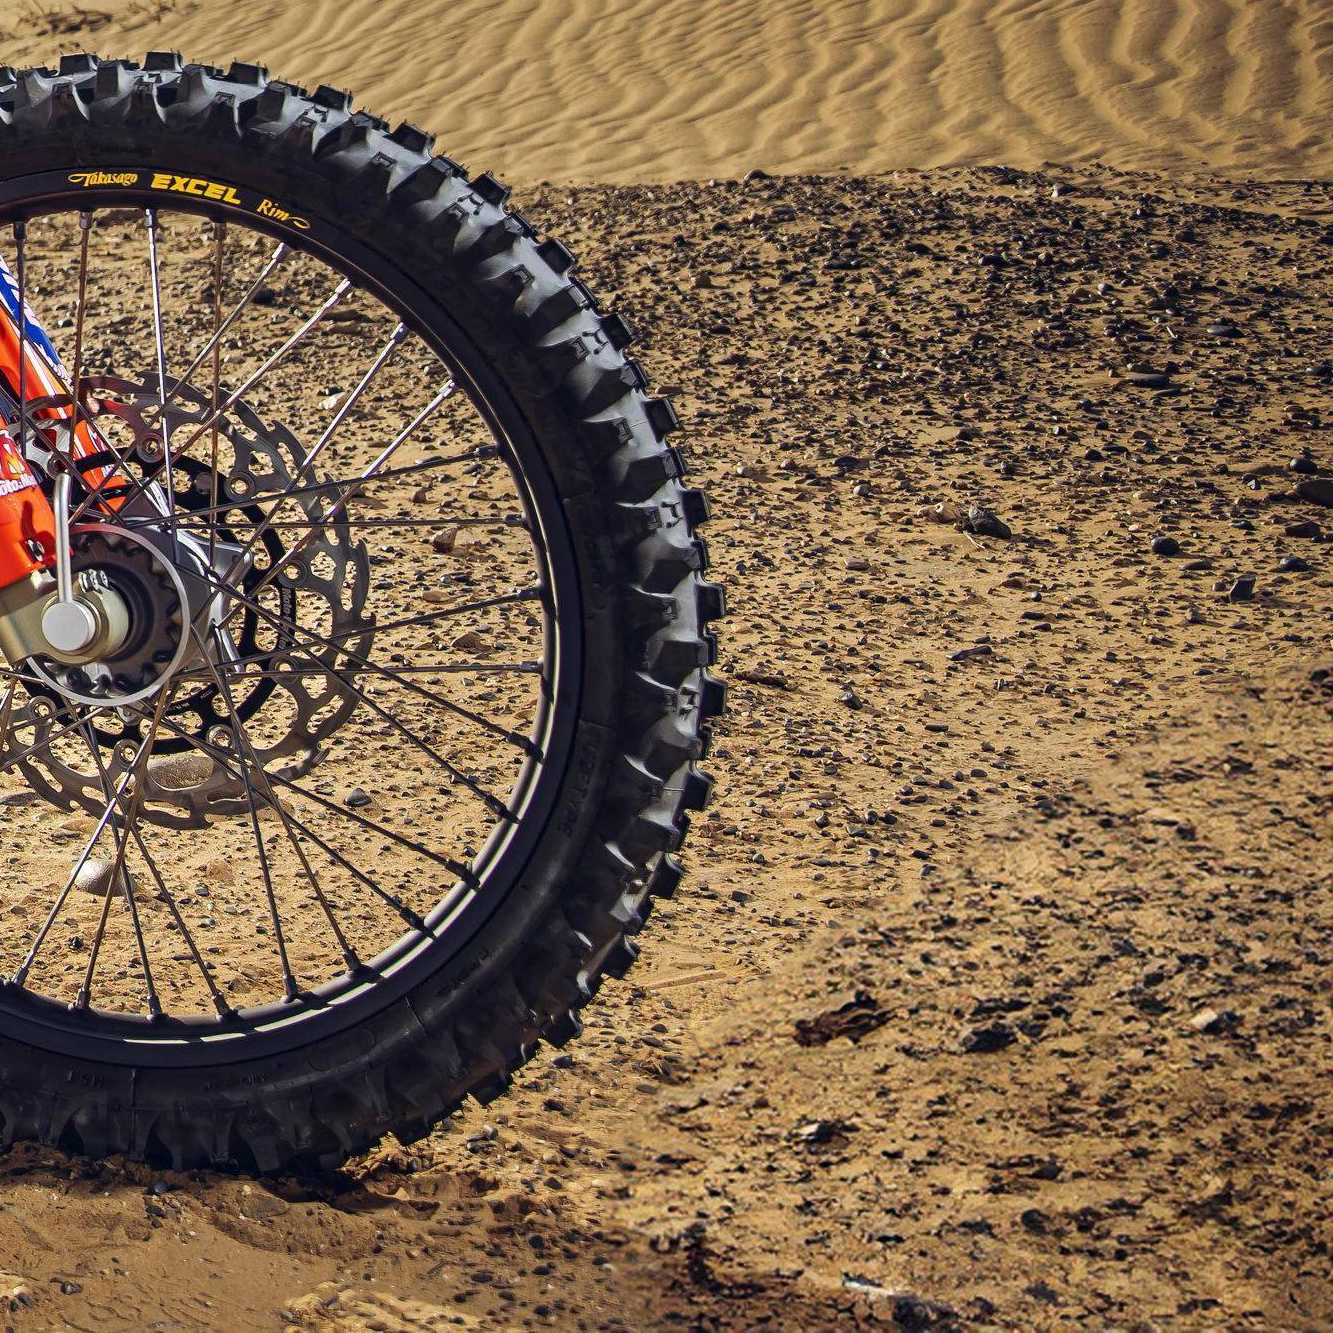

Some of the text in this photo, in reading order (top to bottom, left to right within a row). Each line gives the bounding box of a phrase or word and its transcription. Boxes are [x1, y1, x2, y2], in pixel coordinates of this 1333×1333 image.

[68, 171, 300, 227] Takasago EXCEL Rim
